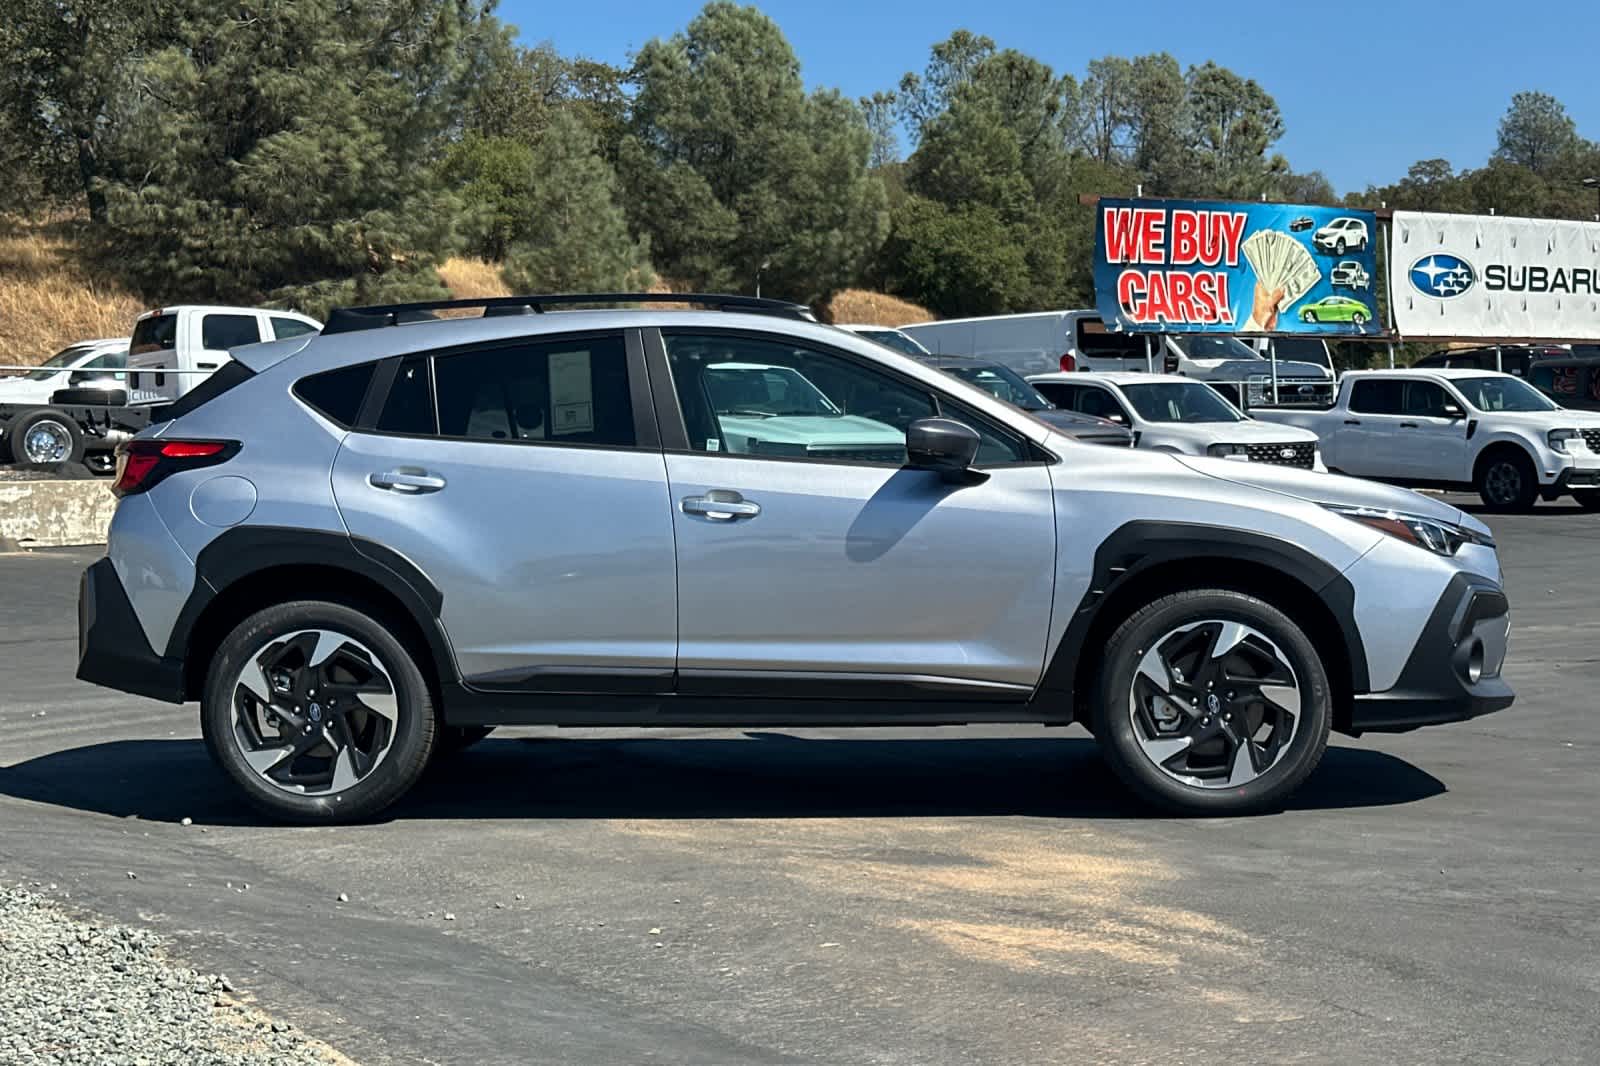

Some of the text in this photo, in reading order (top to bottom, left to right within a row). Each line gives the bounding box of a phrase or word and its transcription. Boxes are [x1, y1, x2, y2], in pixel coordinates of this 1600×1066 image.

[1104, 208, 1248, 266] WE BUY
[1118, 270, 1235, 324] CARS!
